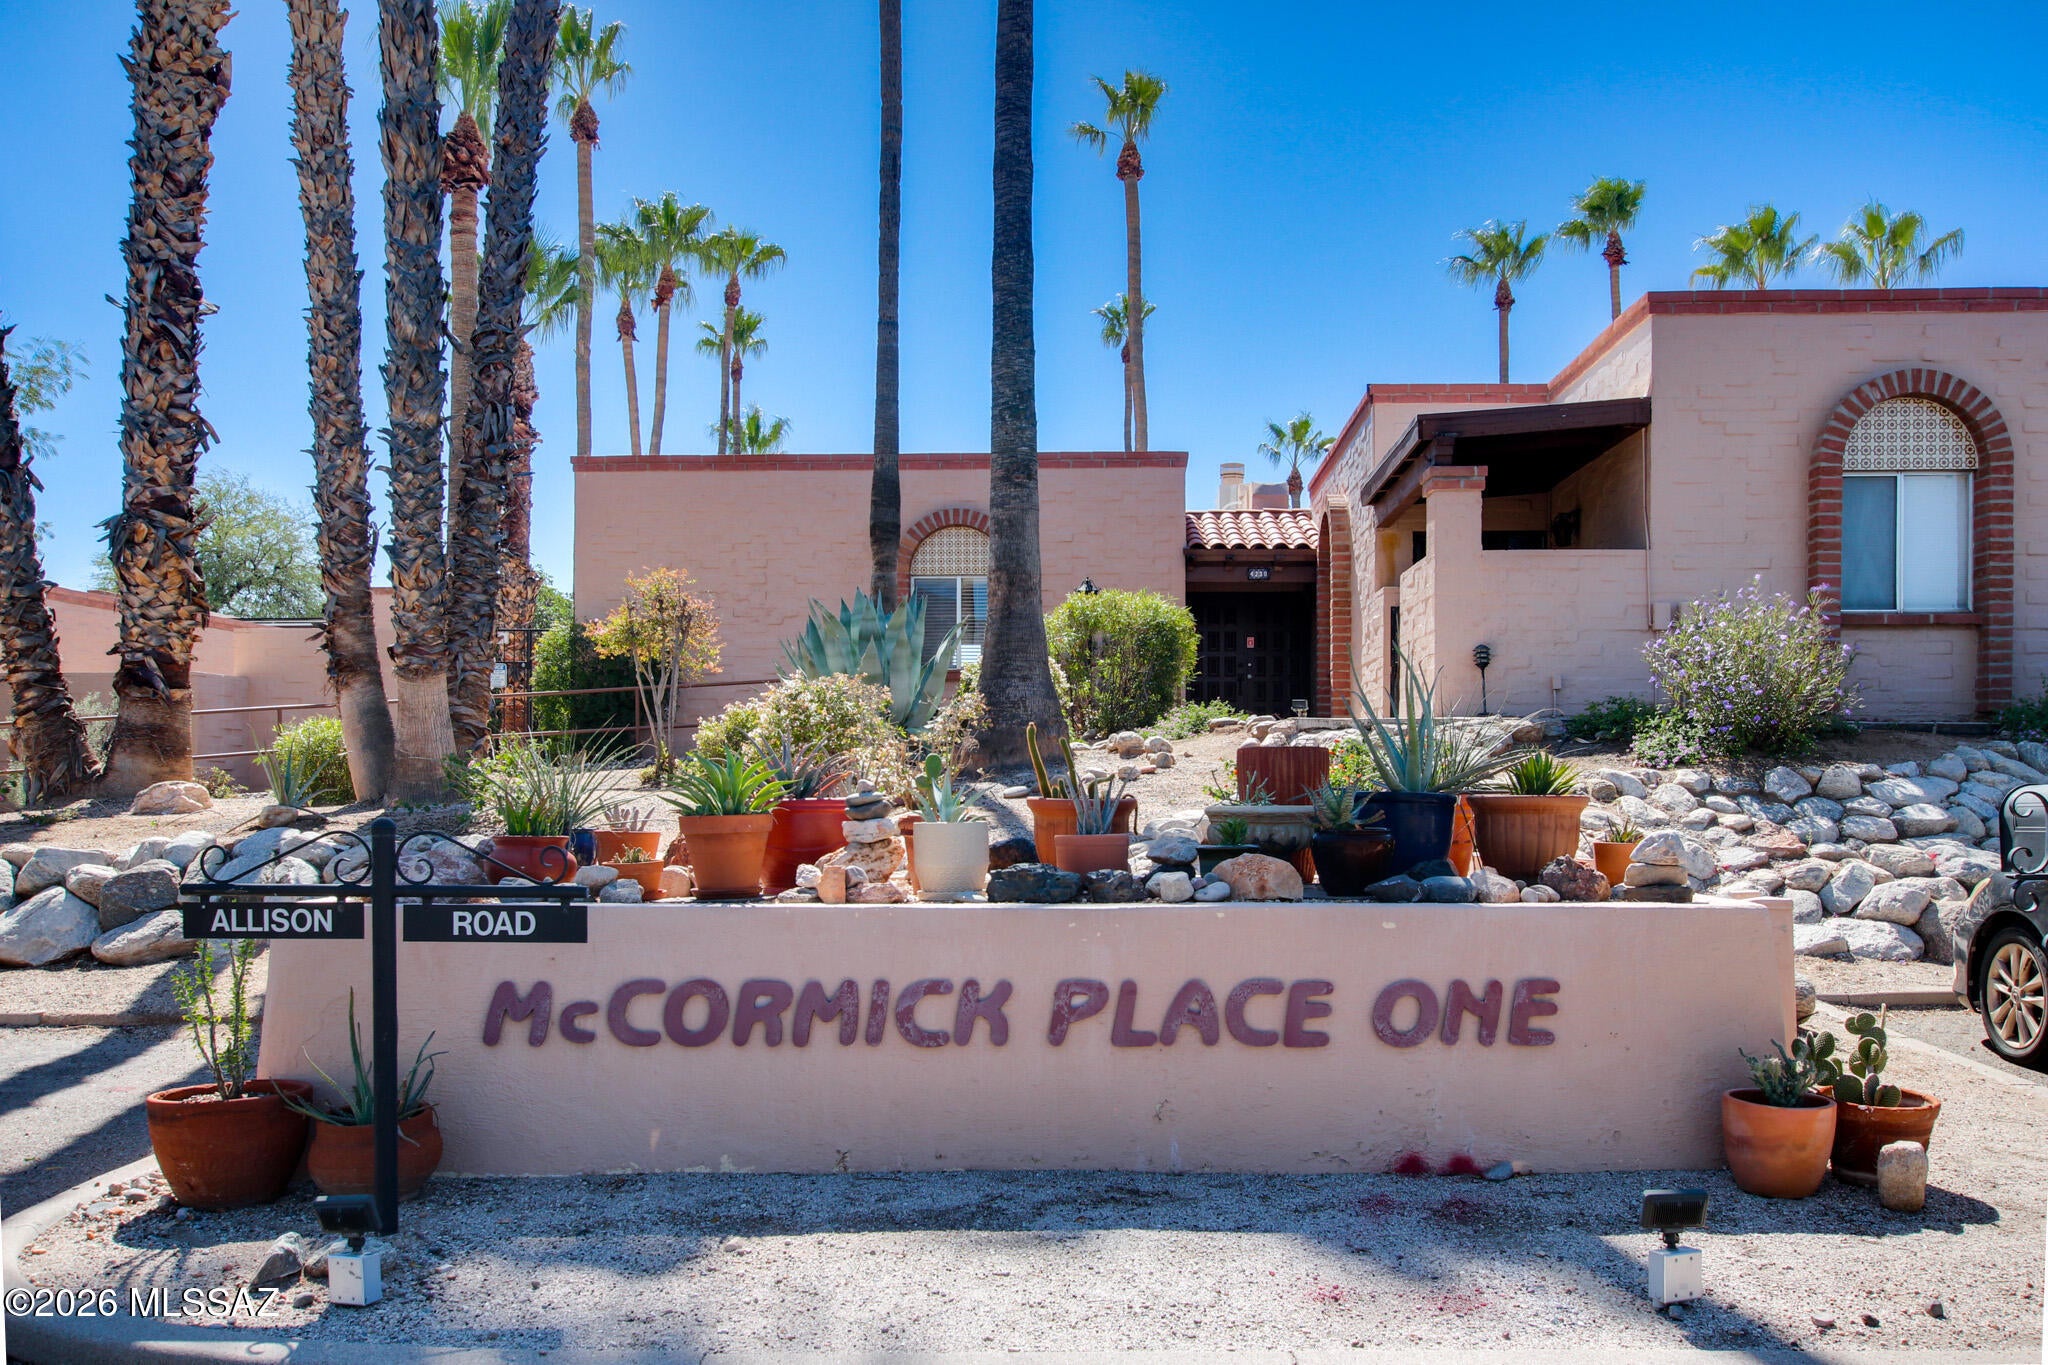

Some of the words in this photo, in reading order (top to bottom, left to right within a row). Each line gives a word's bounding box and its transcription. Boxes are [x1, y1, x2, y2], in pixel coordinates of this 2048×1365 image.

[210, 907, 334, 934] ALLISON
[452, 910, 536, 937] ROAD
[482, 978, 1014, 1048] McCORMICK
[1046, 978, 1335, 1048] PLACE
[1372, 978, 1562, 1048] ONE
